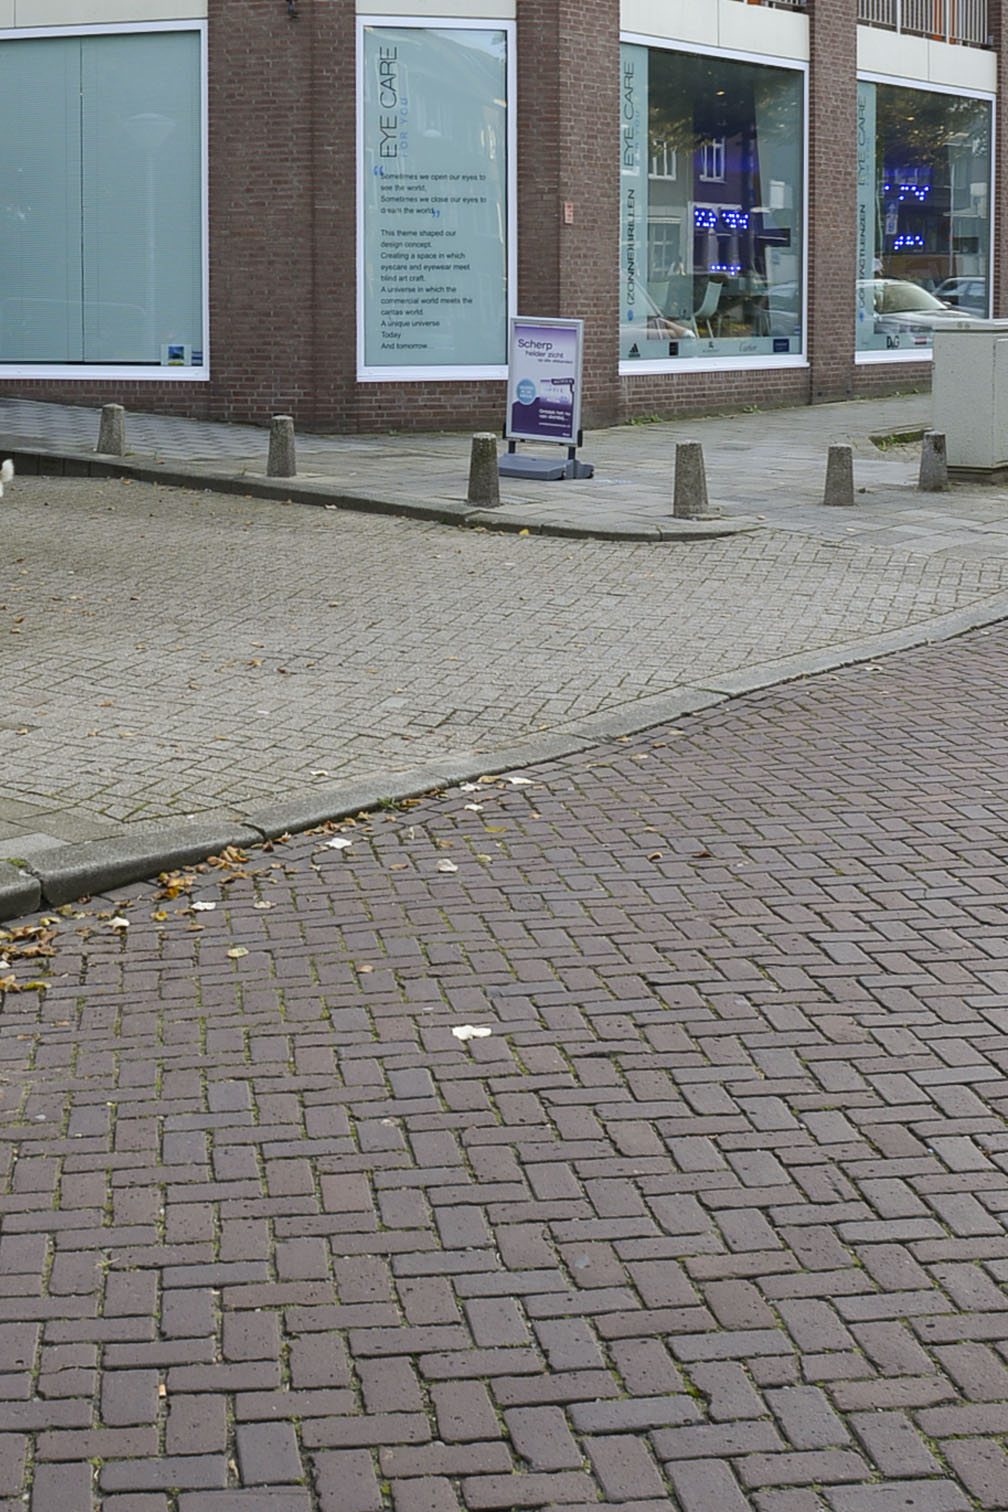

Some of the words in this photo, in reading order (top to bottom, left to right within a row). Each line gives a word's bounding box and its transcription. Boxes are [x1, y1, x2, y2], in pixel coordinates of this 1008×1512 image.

[380, 46, 397, 109] CARE
[624, 61, 634, 120] CARE
[380, 115, 397, 158] EYE
[624, 127, 634, 167] EYE
[380, 195, 417, 203] Sometimes
[381, 229, 395, 237] This
[397, 229, 418, 237] theme
[419, 230, 444, 239] shaped
[380, 241, 403, 249] design
[380, 252, 410, 260] Creating
[447, 252, 466, 260] which
[380, 264, 407, 272] eyecare
[409, 263, 422, 271] and
[380, 274, 397, 282] blind
[380, 297, 419, 305] commercial
[420, 297, 439, 305] world
[388, 321, 410, 329] unique
[381, 331, 402, 340] Today
[518, 338, 553, 351] Scherp
[525, 350, 546, 358] helder
